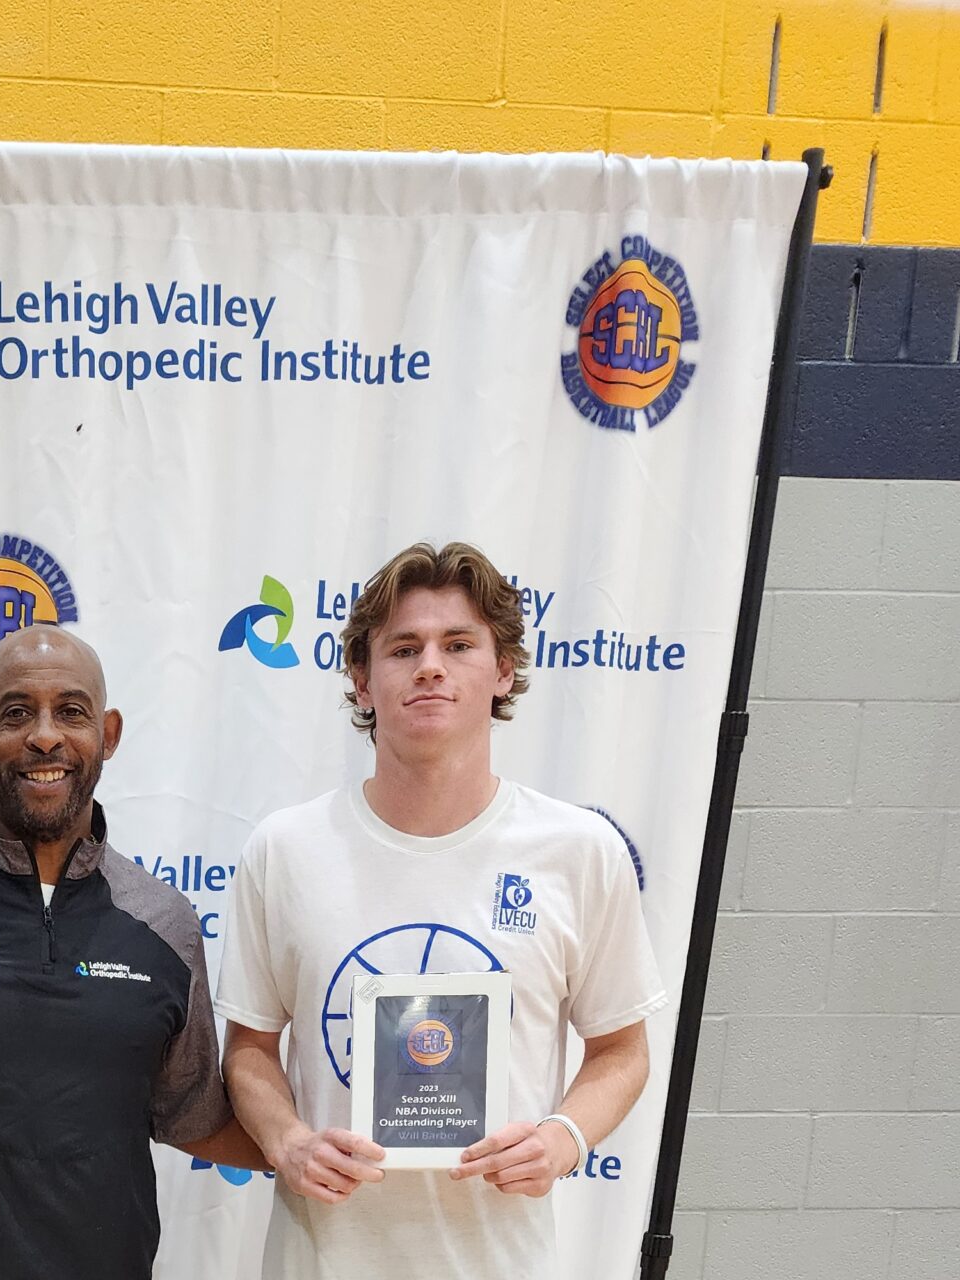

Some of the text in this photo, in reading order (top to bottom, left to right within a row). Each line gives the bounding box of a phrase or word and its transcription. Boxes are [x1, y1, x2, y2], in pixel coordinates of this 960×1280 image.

[146, 281, 276, 339] Valley
[592, 289, 670, 374] SCBL
[261, 339, 431, 385] Institute
[643, 360, 696, 428] LEAGUE
[535, 629, 685, 672] Institute
[499, 908, 537, 929] LVECU
[395, 1106, 462, 1115] NBA Division
[401, 1095, 457, 1103] Season XIII
[379, 1117, 477, 1128] Outstanding Player
[398, 1131, 458, 1140] Will Barber
